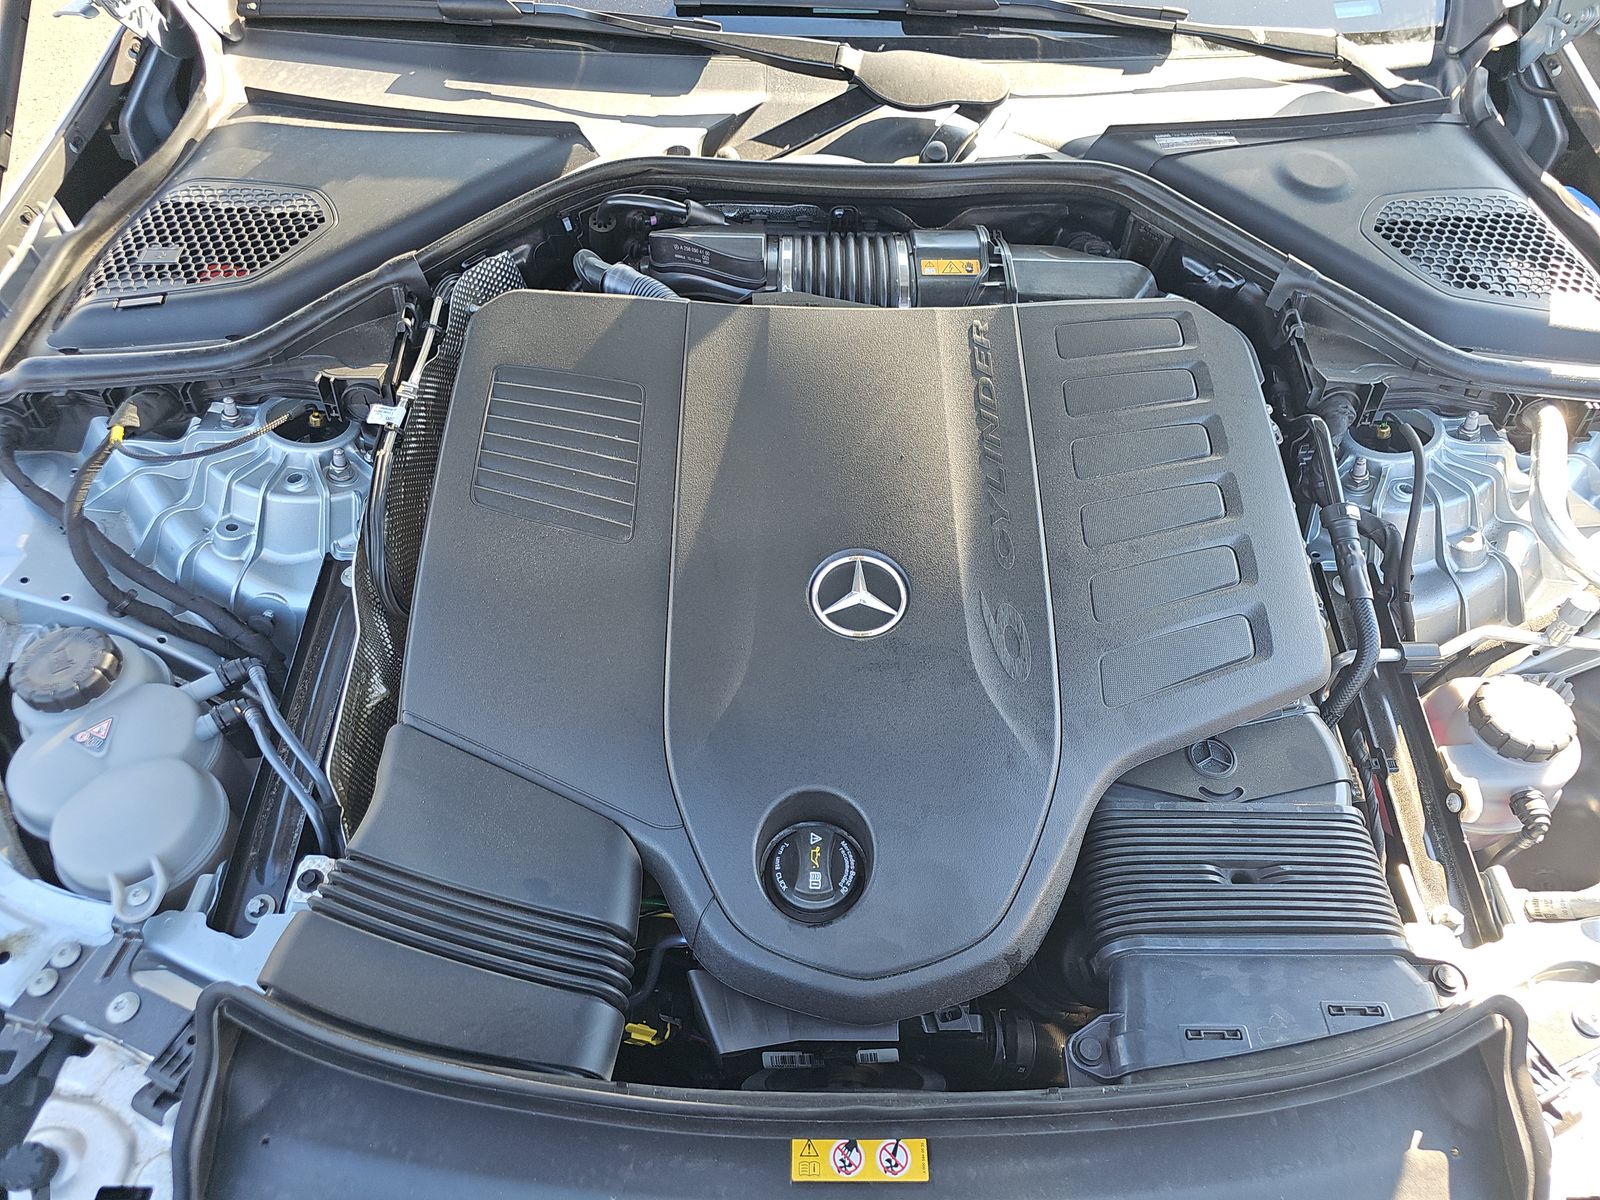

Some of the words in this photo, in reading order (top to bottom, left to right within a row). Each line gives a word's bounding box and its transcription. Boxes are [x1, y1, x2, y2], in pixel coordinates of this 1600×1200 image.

[971, 318, 1015, 570] CYLINDER
[778, 842, 789, 855] Turn
[840, 840, 856, 887] Mercedes-Benz
[776, 872, 788, 892] CLICK
[840, 887, 849, 896] Oil
